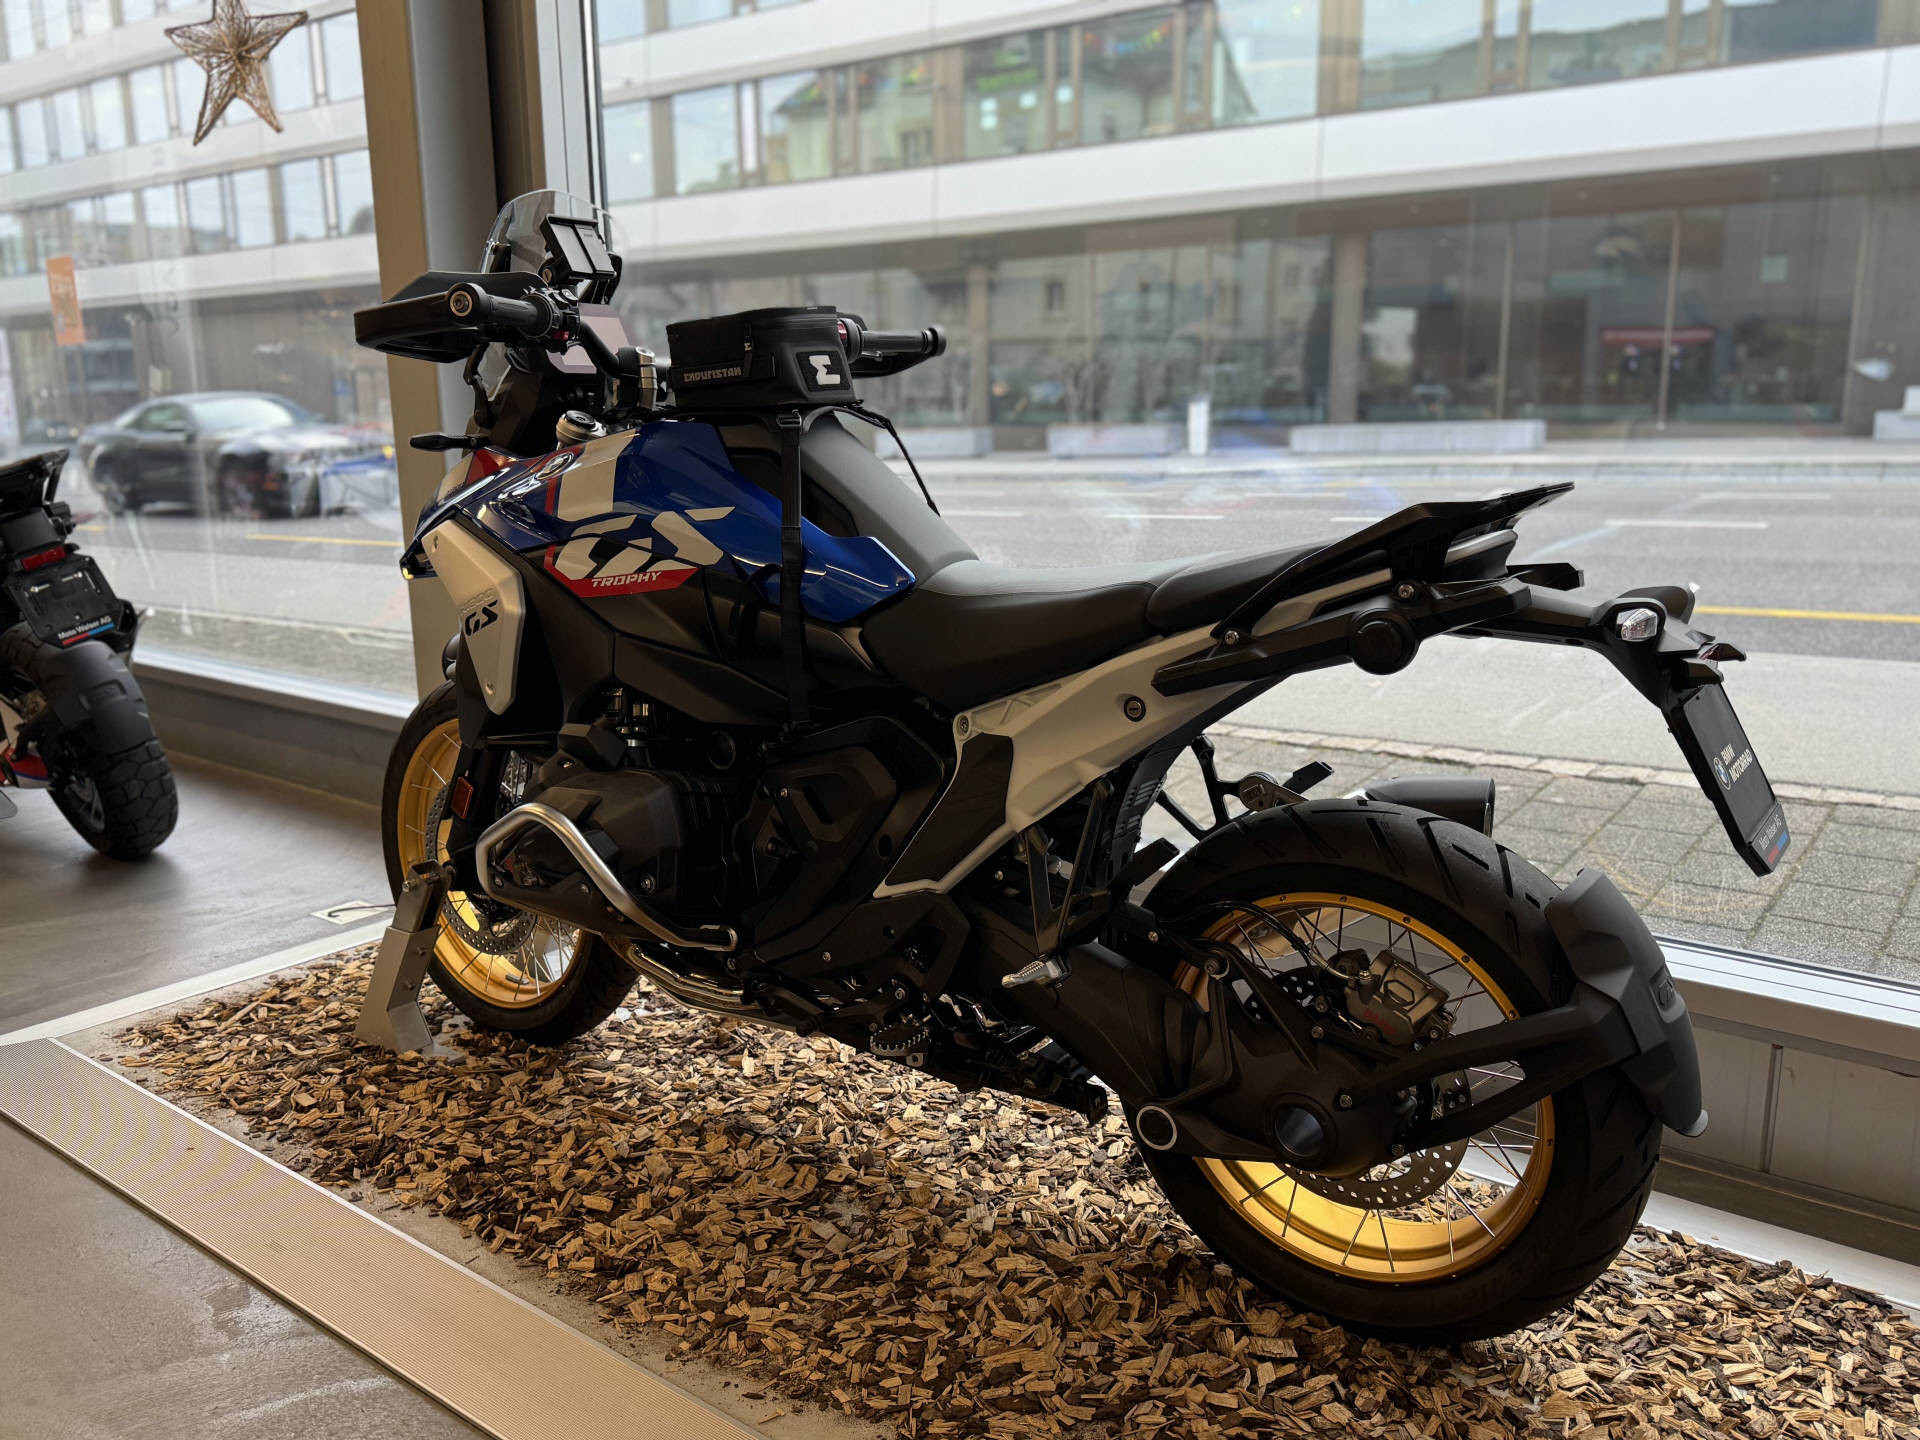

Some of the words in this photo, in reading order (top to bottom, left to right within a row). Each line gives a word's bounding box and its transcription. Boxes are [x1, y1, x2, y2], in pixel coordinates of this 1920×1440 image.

[591, 570, 663, 588] TROPHY
[465, 600, 498, 636] GS
[1721, 743, 1736, 766] BMW
[1729, 748, 1753, 783] MOTORRAD
